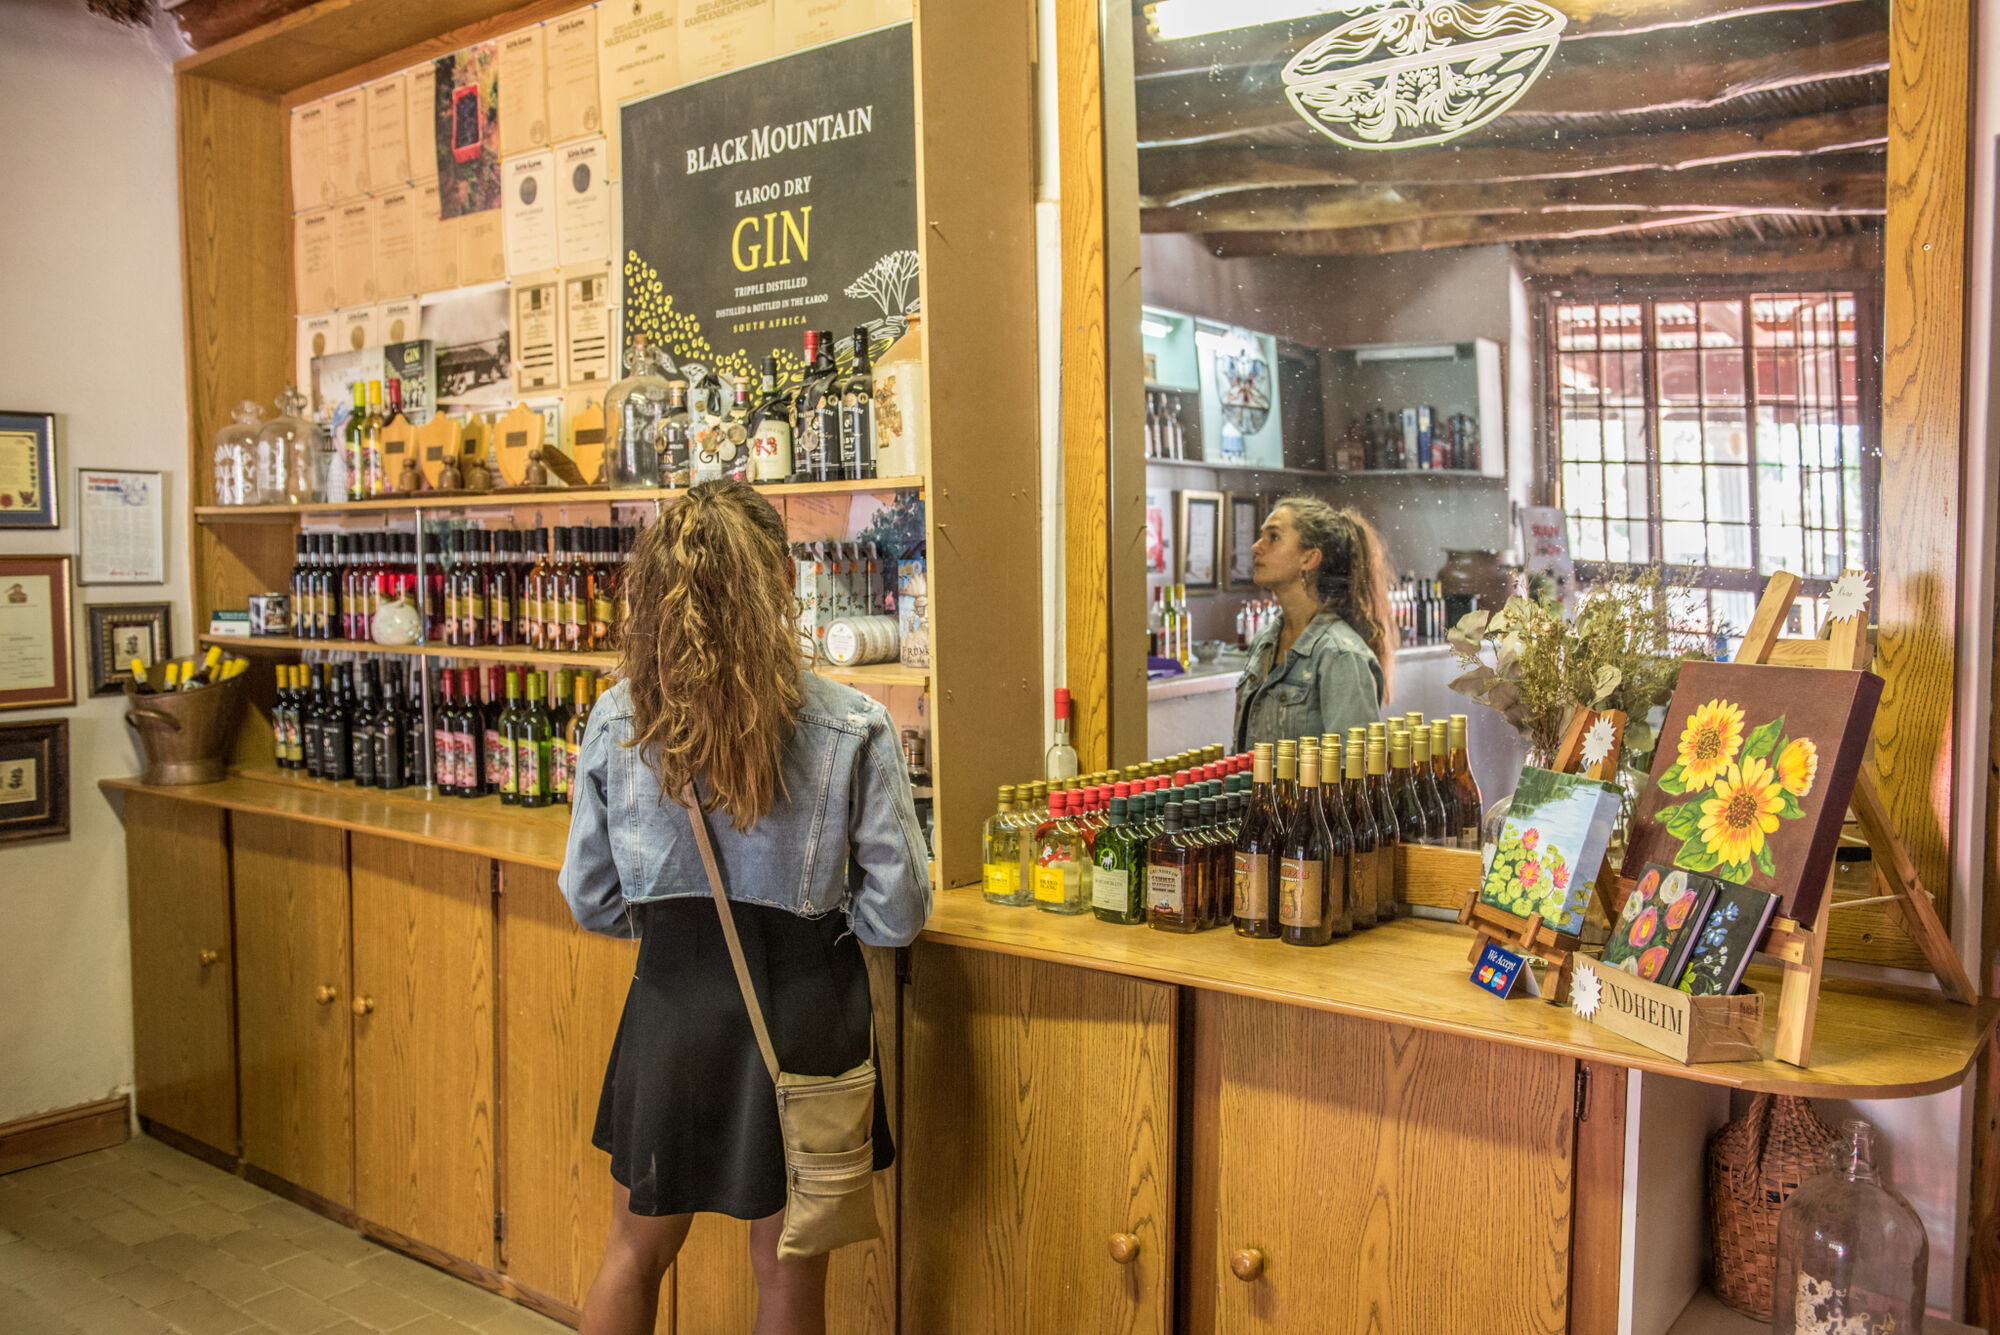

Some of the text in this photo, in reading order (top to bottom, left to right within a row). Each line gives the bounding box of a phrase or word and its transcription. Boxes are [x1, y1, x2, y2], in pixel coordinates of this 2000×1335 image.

[735, 175, 812, 208] KAROO DRY
[731, 205, 812, 273] GIN
[734, 276, 808, 298] TRIPPLE DISTILLED
[715, 303, 746, 318] DISTILLED
[752, 298, 780, 314] BOTTLED
[781, 297, 790, 308] IN
[790, 295, 804, 307] THE
[805, 293, 828, 305] KAROO
[733, 315, 807, 334] SOUTH AFRICA
[404, 347, 420, 363] GIN
[1487, 949, 1517, 973] We Accept
[1597, 979, 1684, 1036] UNDHEIM
